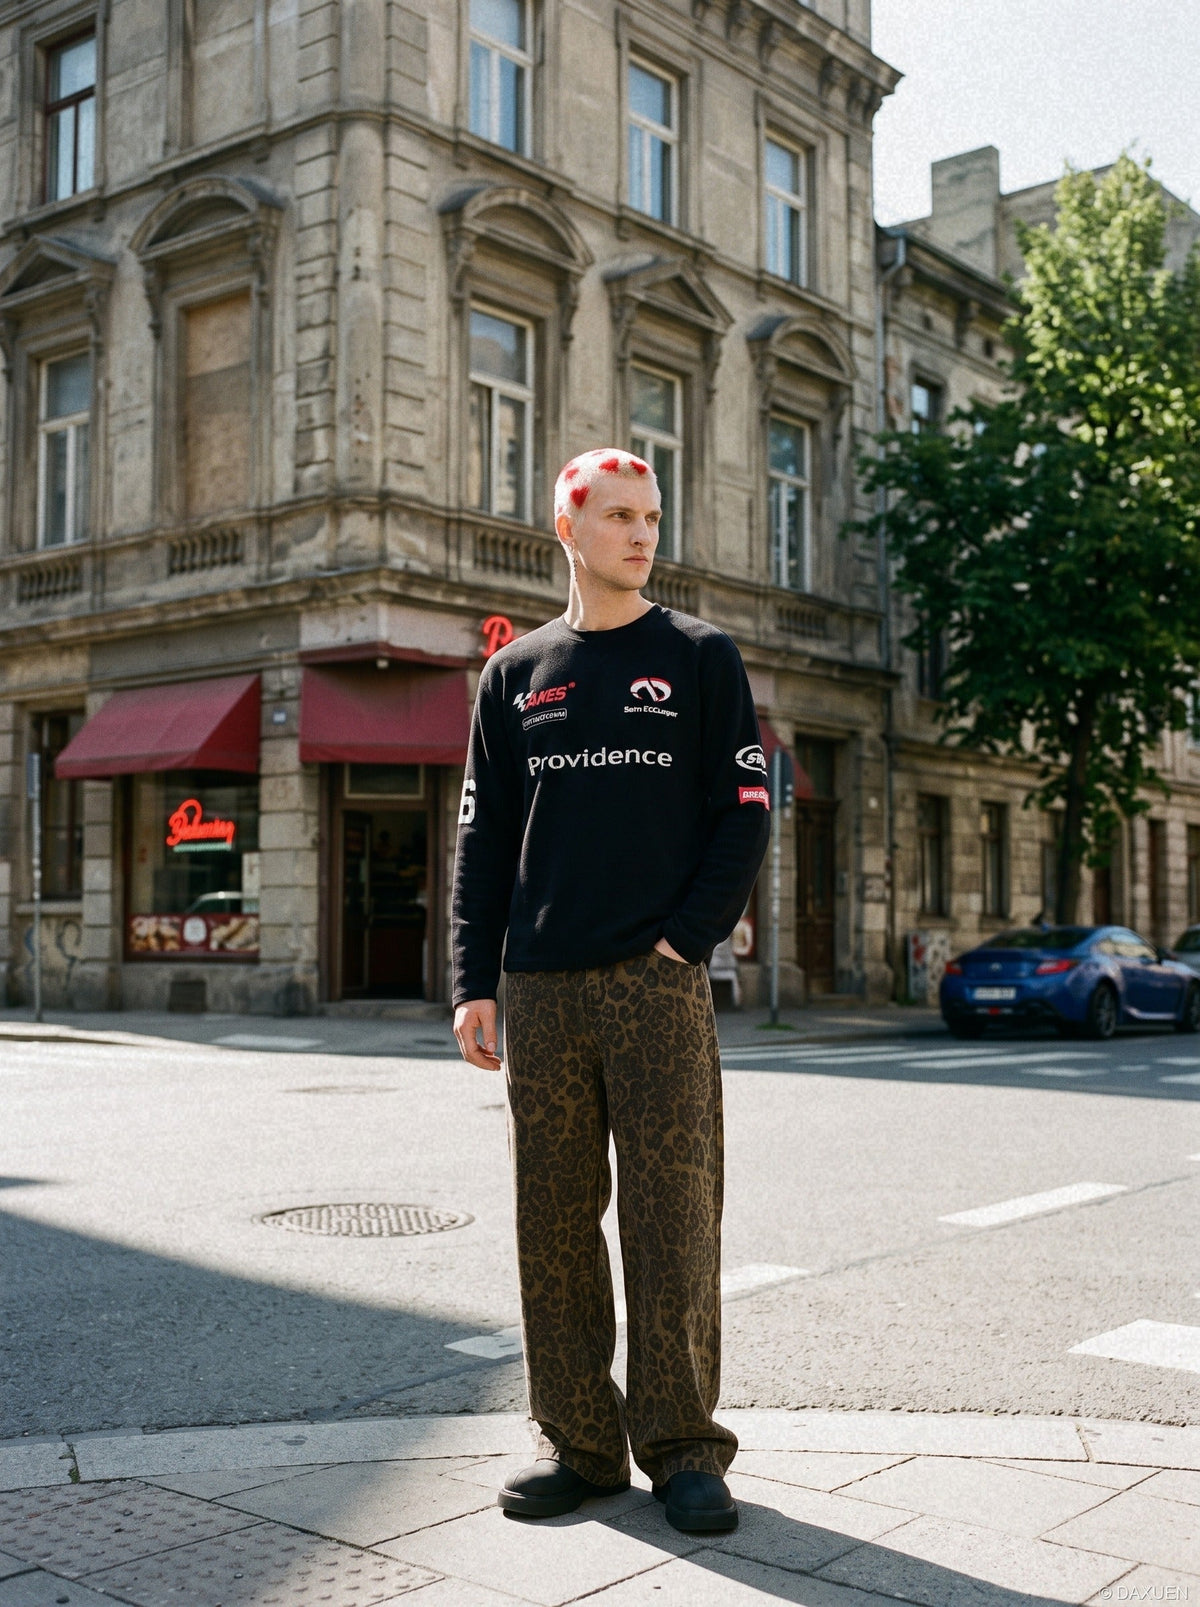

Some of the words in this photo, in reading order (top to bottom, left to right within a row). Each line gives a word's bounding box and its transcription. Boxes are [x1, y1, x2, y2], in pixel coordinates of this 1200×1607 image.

[483, 615, 518, 658] P
[527, 746, 673, 776] Providence
[458, 779, 476, 824] 6
